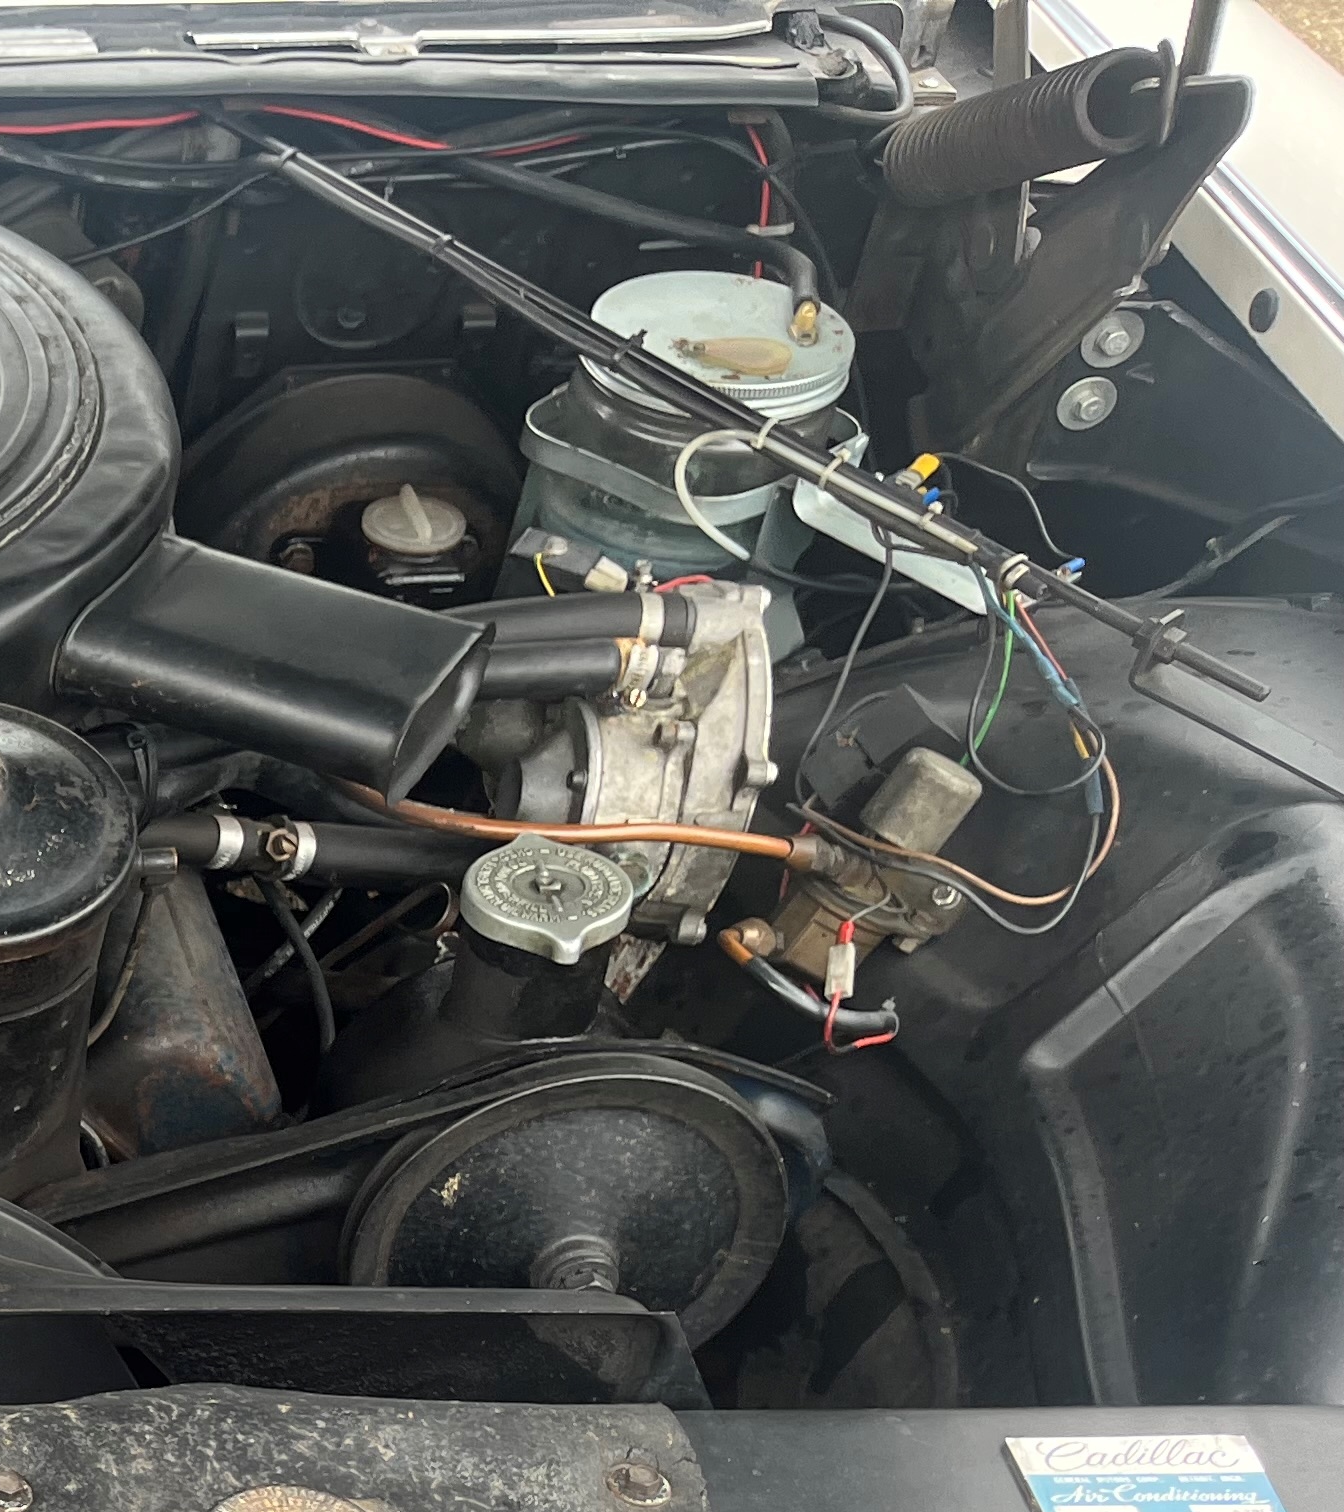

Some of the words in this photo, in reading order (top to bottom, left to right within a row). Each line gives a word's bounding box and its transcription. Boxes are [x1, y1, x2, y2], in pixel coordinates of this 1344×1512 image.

[1035, 1438, 1240, 1472] Cadillac
[1051, 1485, 1110, 1504] Air
[1111, 1482, 1269, 1505] Conditioning
